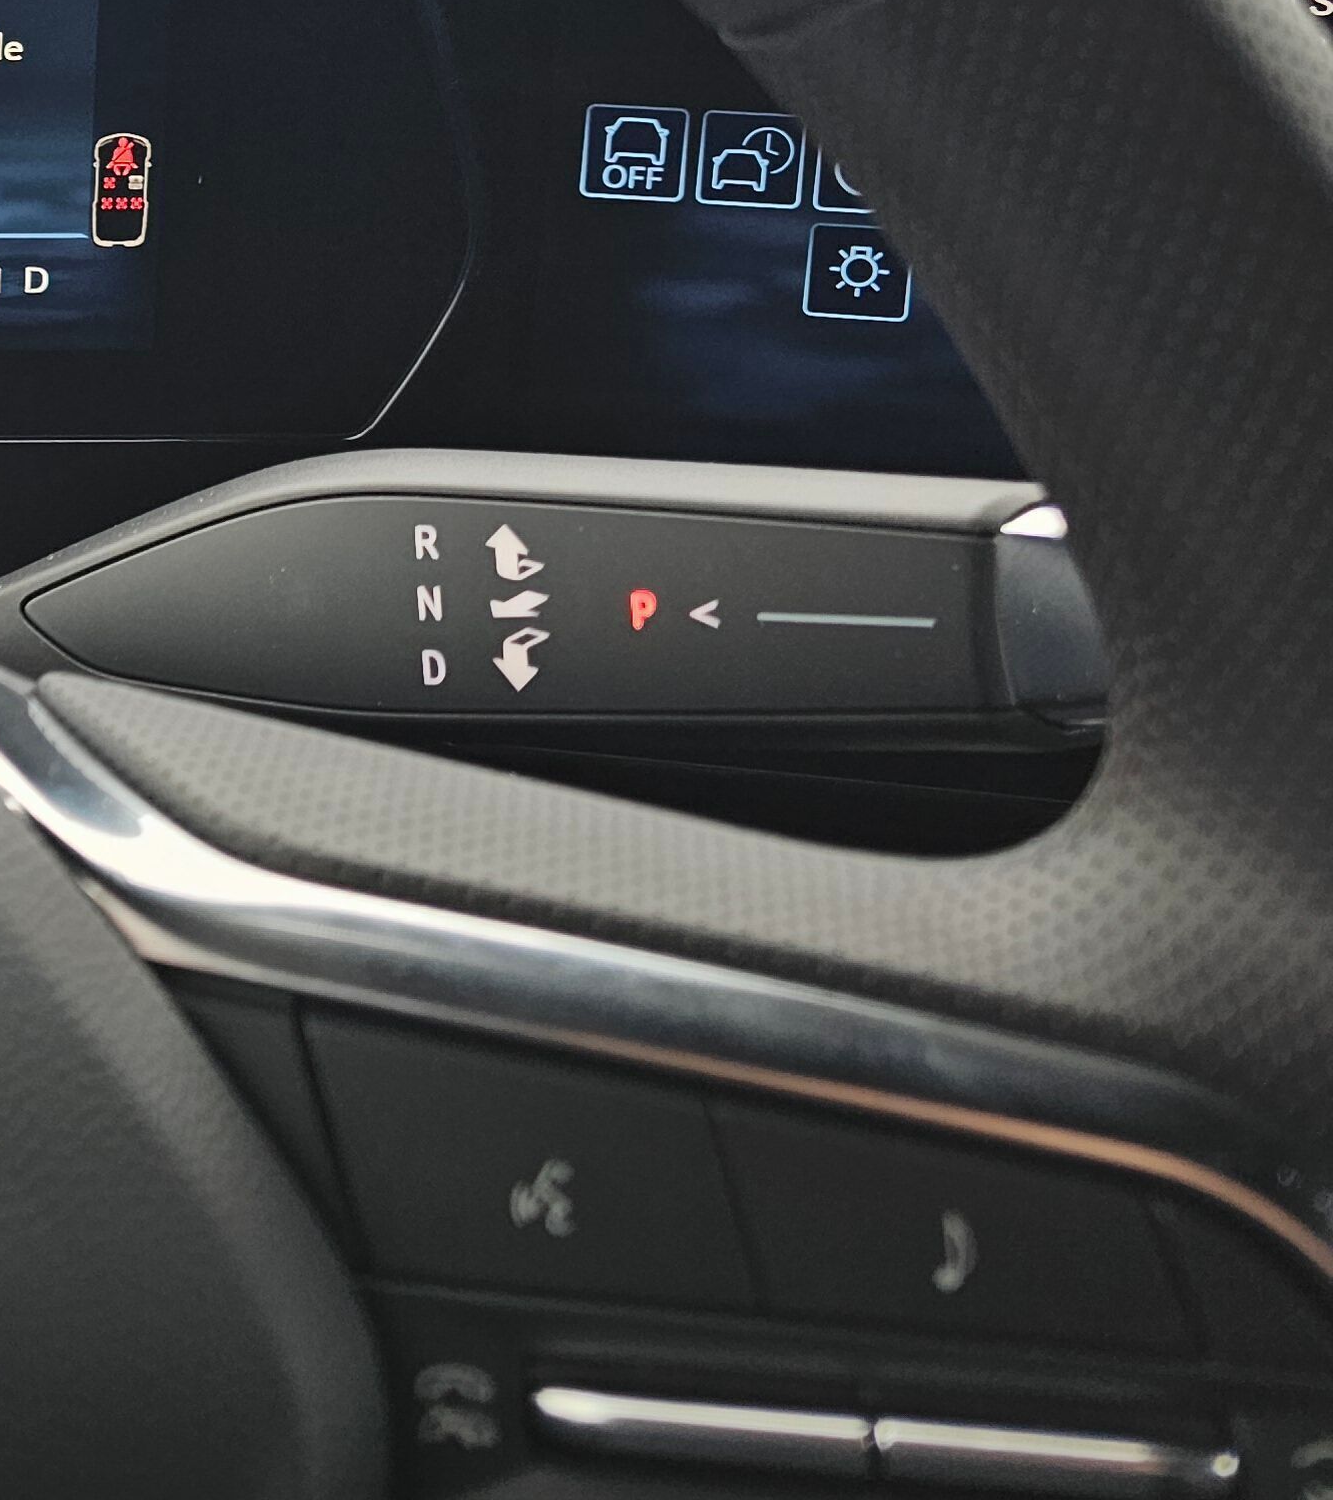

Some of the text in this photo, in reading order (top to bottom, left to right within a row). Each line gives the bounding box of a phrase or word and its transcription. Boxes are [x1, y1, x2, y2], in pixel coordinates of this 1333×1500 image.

[601, 165, 664, 190] OFF
[25, 267, 49, 293] D
[415, 525, 439, 560] R
[417, 585, 442, 621] N
[630, 588, 657, 630] P
[422, 650, 446, 685] D
